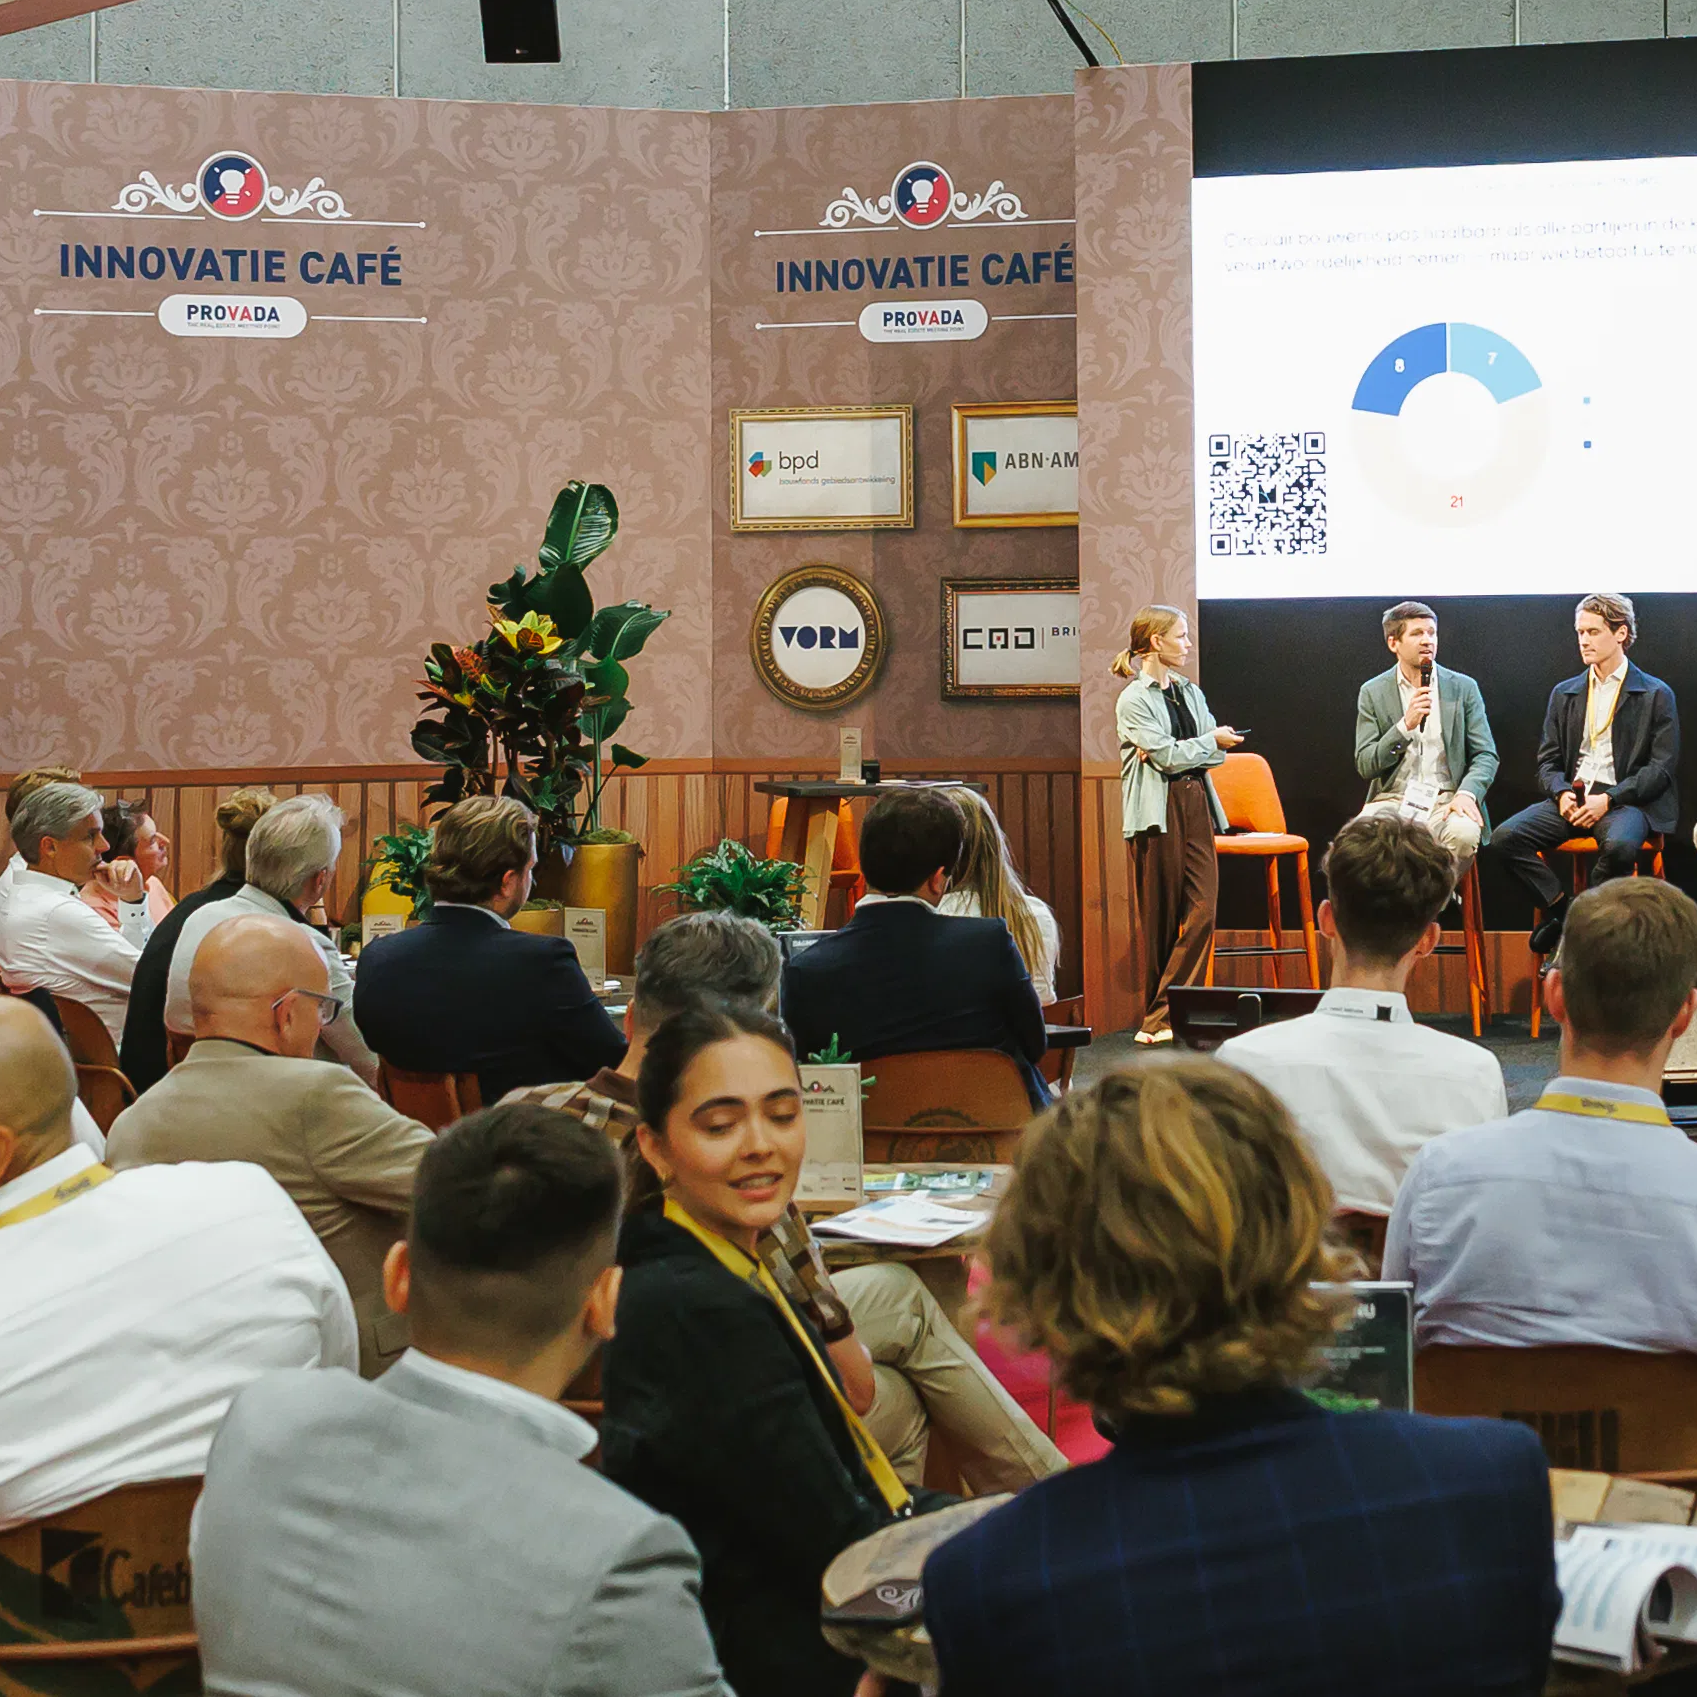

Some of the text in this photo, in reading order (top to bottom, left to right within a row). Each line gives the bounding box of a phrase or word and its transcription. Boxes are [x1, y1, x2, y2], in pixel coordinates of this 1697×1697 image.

[59, 243, 402, 286] INNOVATIE CAFÉ
[776, 242, 1074, 292] INNOVATIE CAFÉ
[187, 304, 281, 322] PROVADA
[883, 309, 964, 327] PROVADA
[1394, 358, 1405, 373] 8
[1487, 352, 1498, 366] 7
[779, 450, 819, 474] bpd
[1005, 452, 1079, 469] ABN·AM
[1450, 495, 1464, 508] 21
[778, 625, 859, 649] VORM
[1051, 626, 1080, 636] BRI
